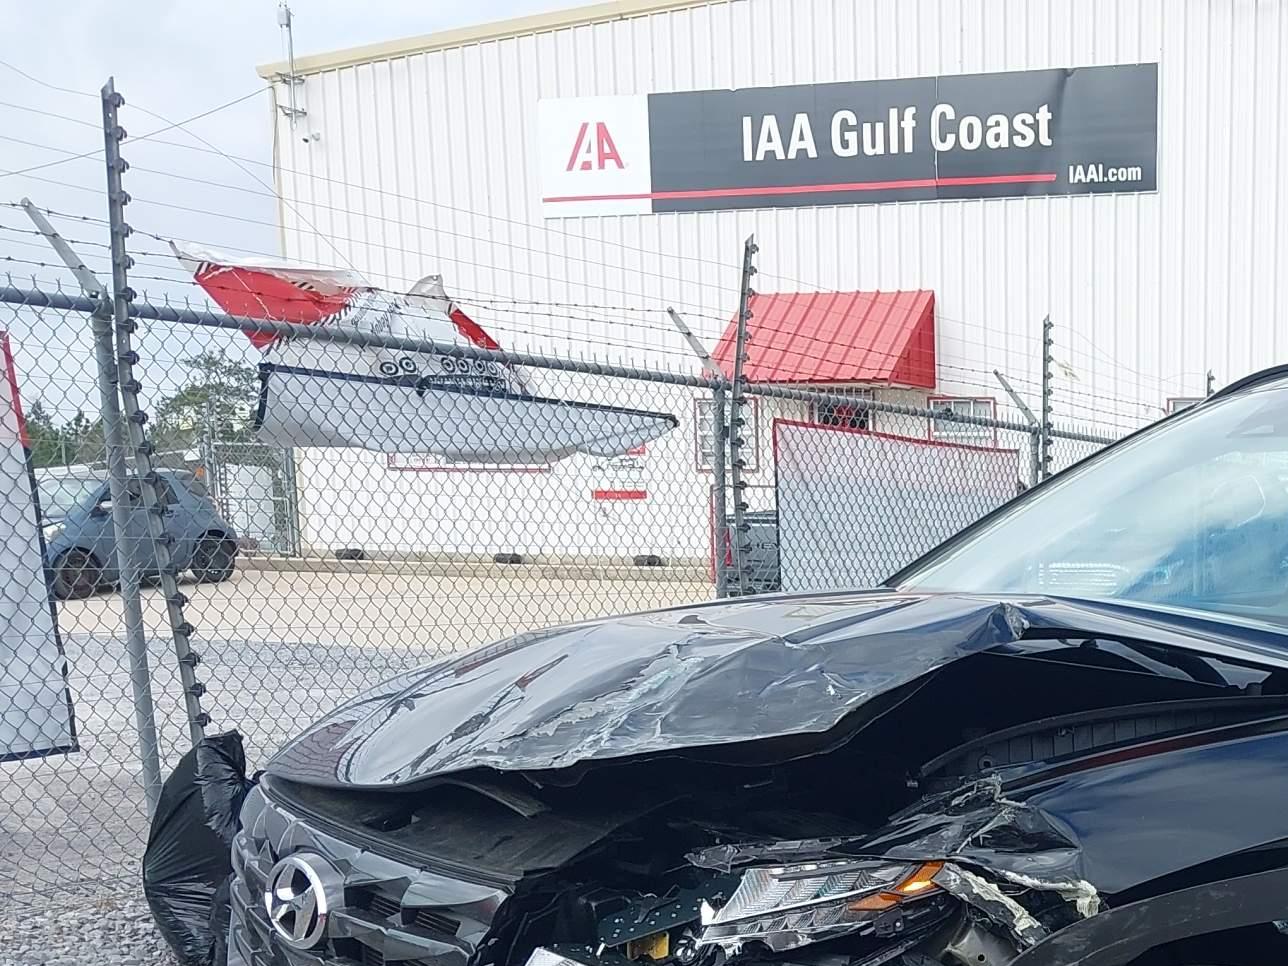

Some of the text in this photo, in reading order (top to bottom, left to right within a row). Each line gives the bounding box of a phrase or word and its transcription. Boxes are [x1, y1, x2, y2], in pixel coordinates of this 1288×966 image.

[742, 103, 1053, 162] IAA Gulf Coast
[1069, 163, 1143, 184] IAAI.com
